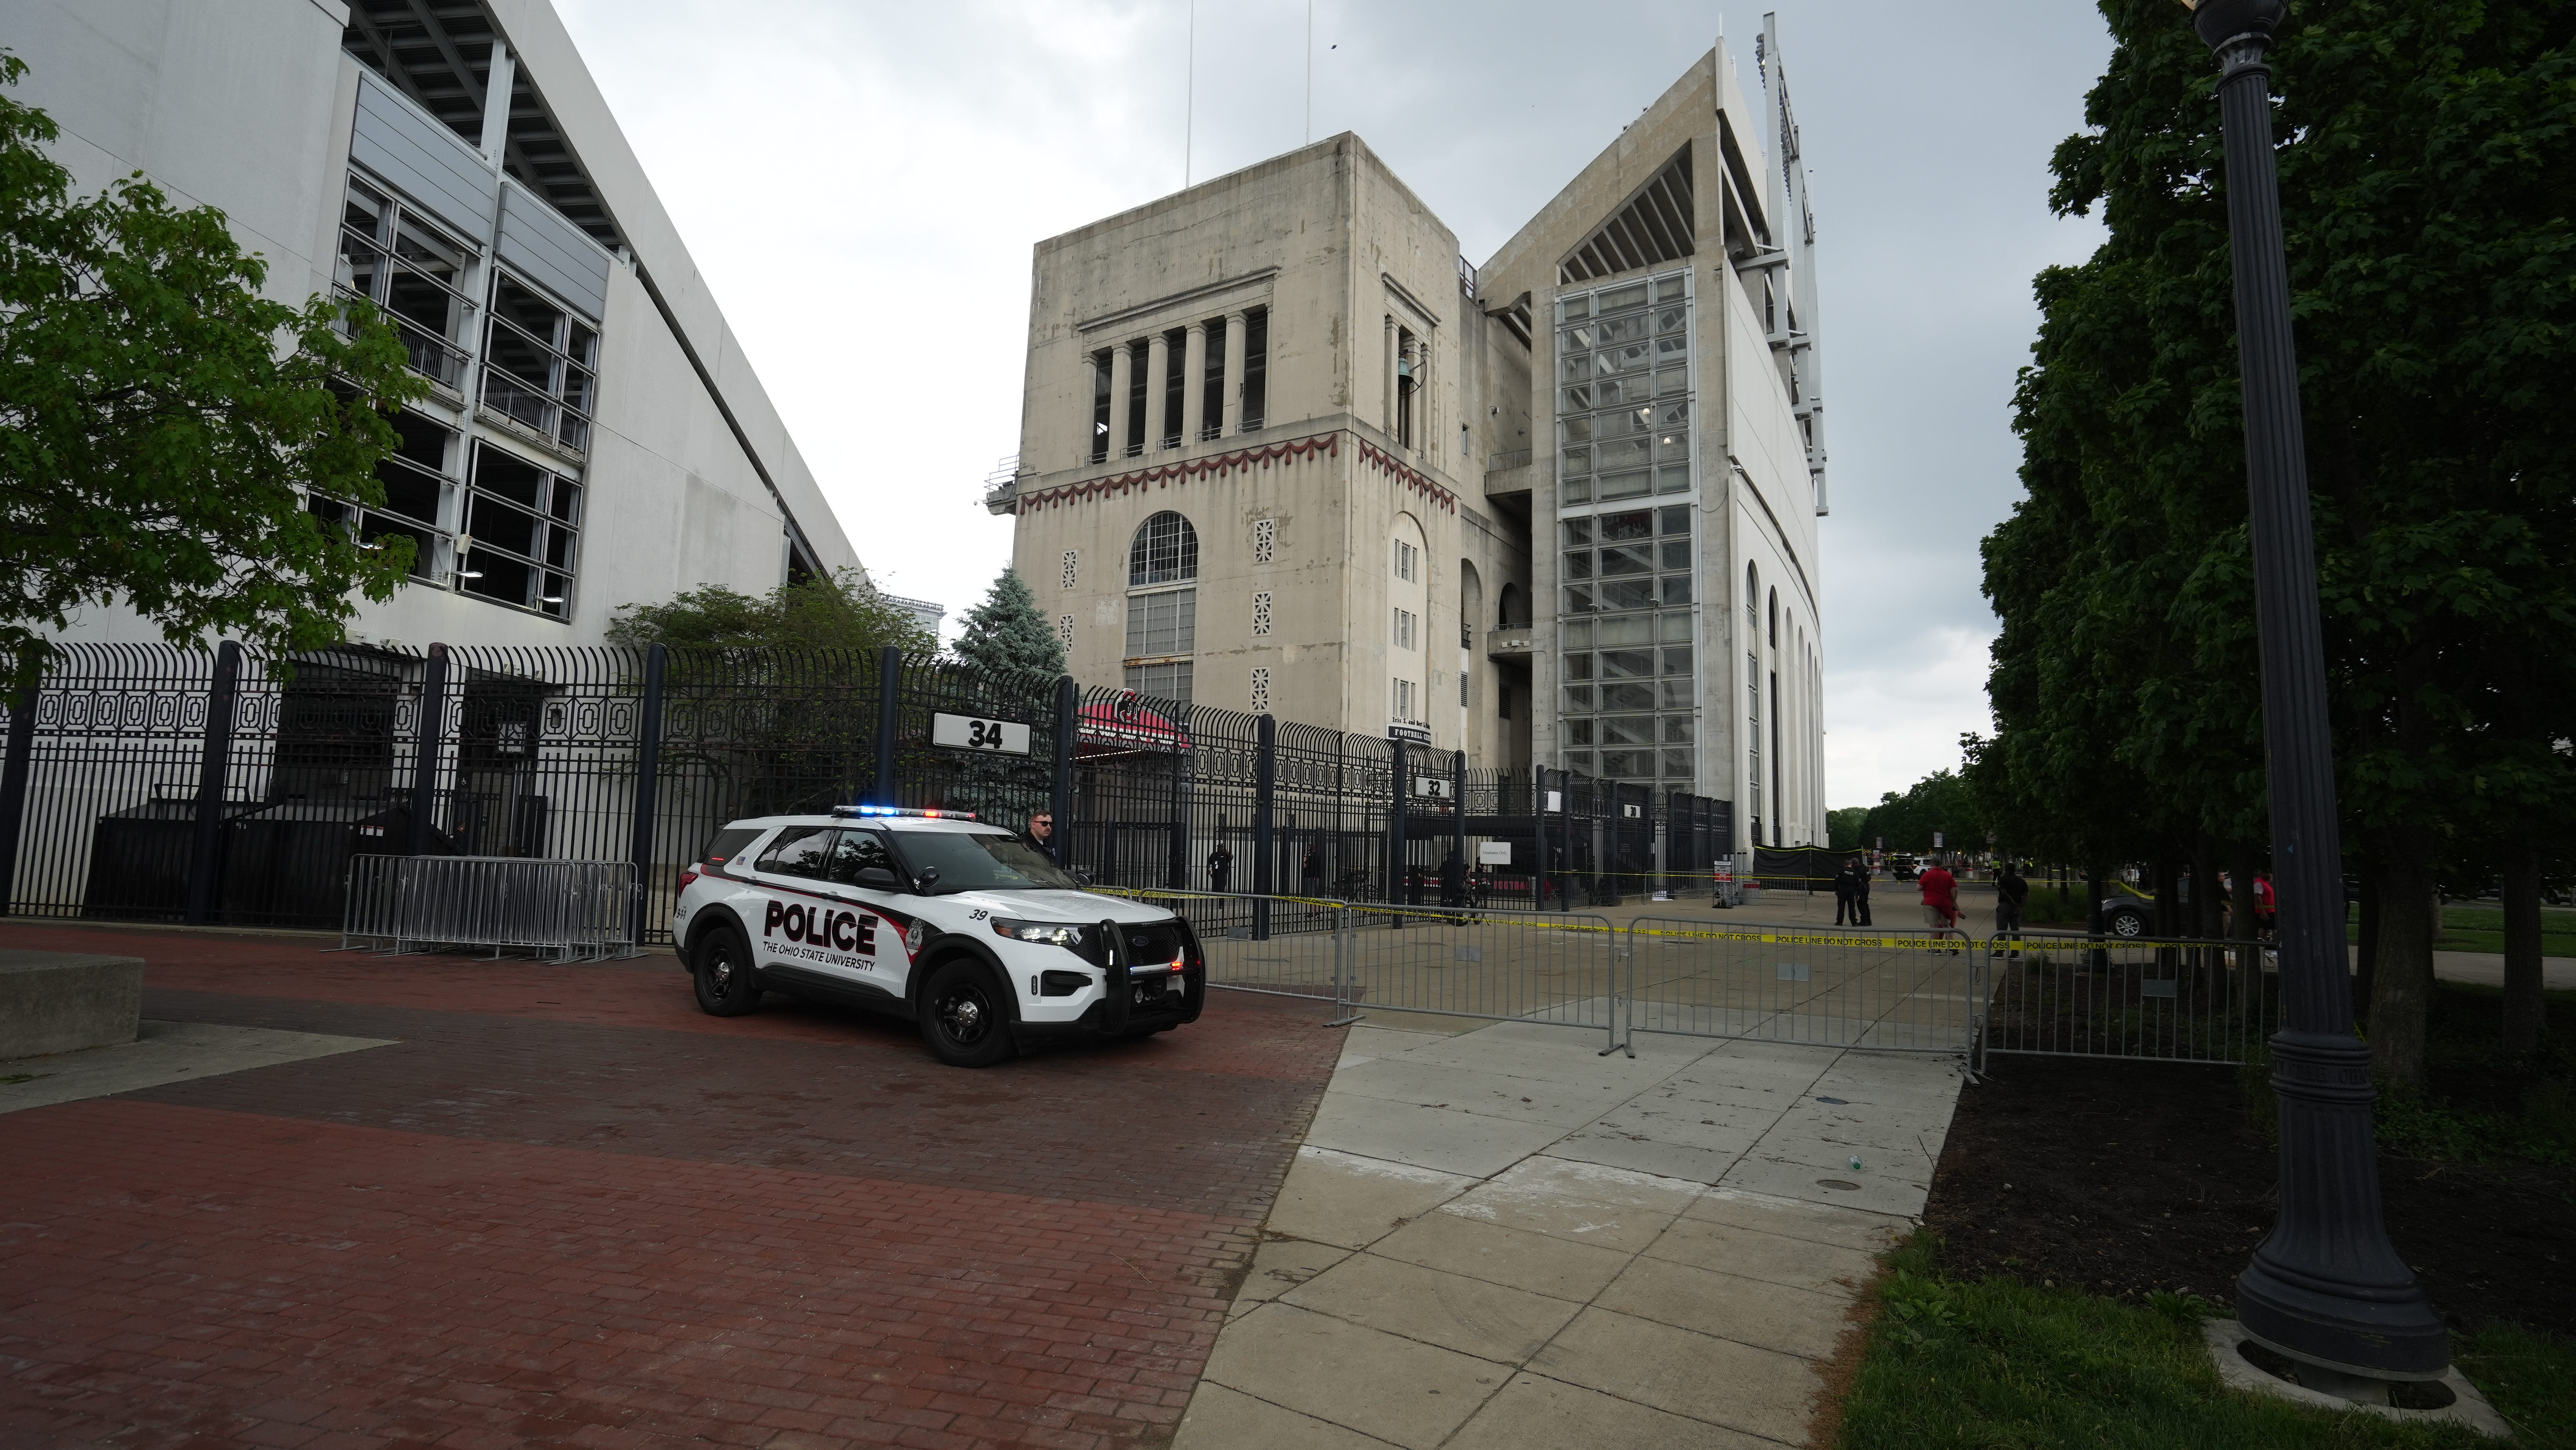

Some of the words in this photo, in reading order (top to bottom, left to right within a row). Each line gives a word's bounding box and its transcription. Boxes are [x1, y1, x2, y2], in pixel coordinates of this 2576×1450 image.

[968, 720, 1002, 749] 34
[1395, 729, 1422, 739] FOOTBALL
[1428, 780, 1440, 796] 32
[1631, 807, 1636, 817] 30
[676, 908, 686, 920] 9-1-1
[969, 909, 988, 921] 39
[764, 900, 879, 956] POLICE
[763, 941, 778, 953] THE
[779, 944, 799, 957] OHIO
[800, 949, 824, 962] STATE
[826, 953, 875, 971] UNIVERSITY
[2292, 1062, 2327, 1082] THE
